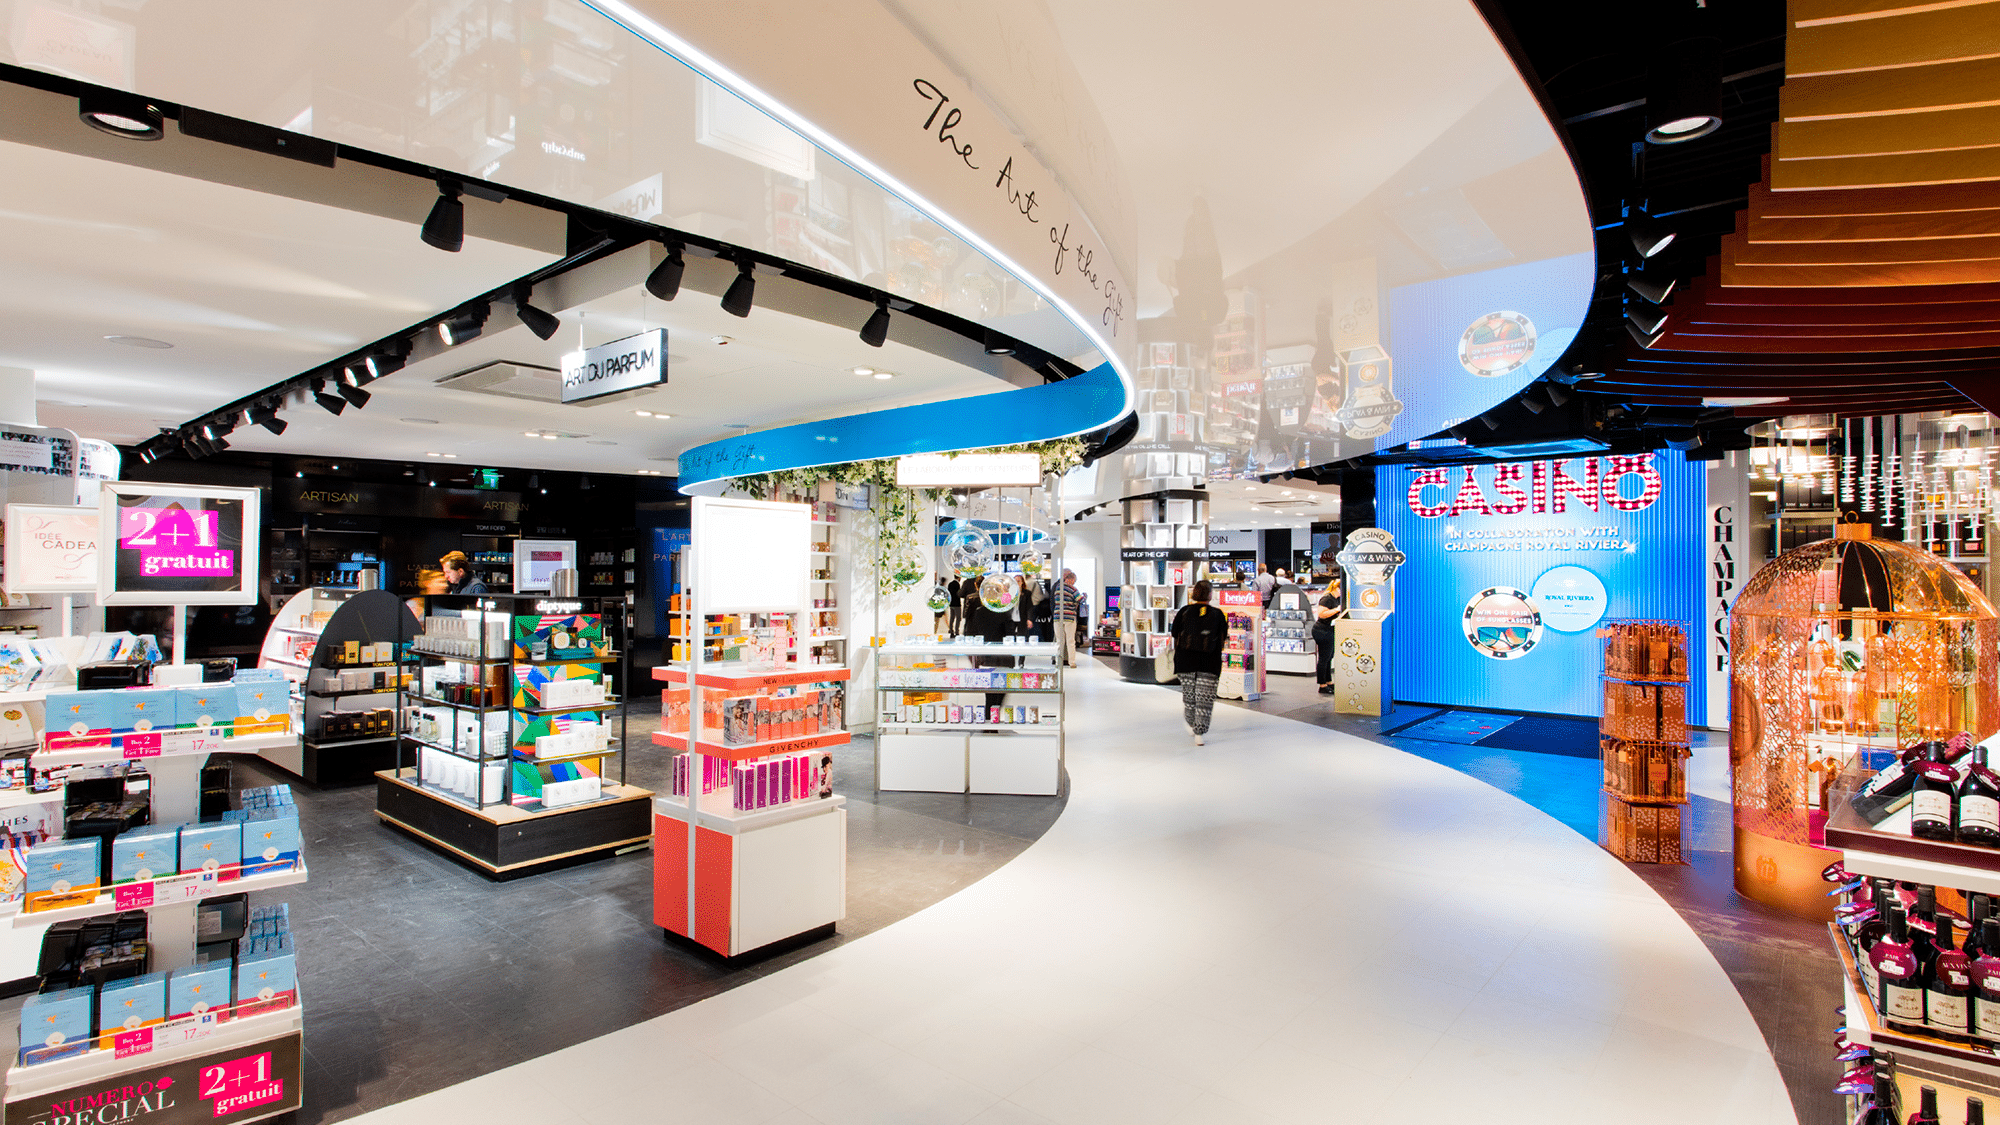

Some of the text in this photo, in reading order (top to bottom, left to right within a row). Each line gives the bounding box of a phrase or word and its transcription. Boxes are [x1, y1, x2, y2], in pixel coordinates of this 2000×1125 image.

[913, 78, 1124, 337] The Art of the Gift
[565, 347, 655, 388] ART DU PARFUM
[1407, 453, 1663, 519] CASINO
[300, 490, 359, 503] ARTISAN
[482, 501, 530, 511] ARTISAN
[126, 511, 216, 547] 2+1
[476, 524, 490, 532] TOM
[1466, 528, 1575, 539] COLLABORATION
[1580, 526, 1620, 536] WITH
[1354, 531, 1386, 541] CASINO
[42, 540, 97, 550] CADEA
[1444, 540, 1631, 551] CHAMPAGNE ROYAL RIVIERA
[144, 551, 231, 575] gratuit
[1348, 555, 1368, 563] PLAY
[1375, 554, 1393, 562] WIN
[1713, 505, 1735, 672] CHAMPAGNE
[1225, 593, 1256, 604] benefit
[536, 601, 583, 613] diptyque
[143, 735, 151, 745] 2
[769, 739, 819, 754] GIVENCHY
[205, 1055, 268, 1097] 2+1
[216, 1083, 283, 1115] gratuit
